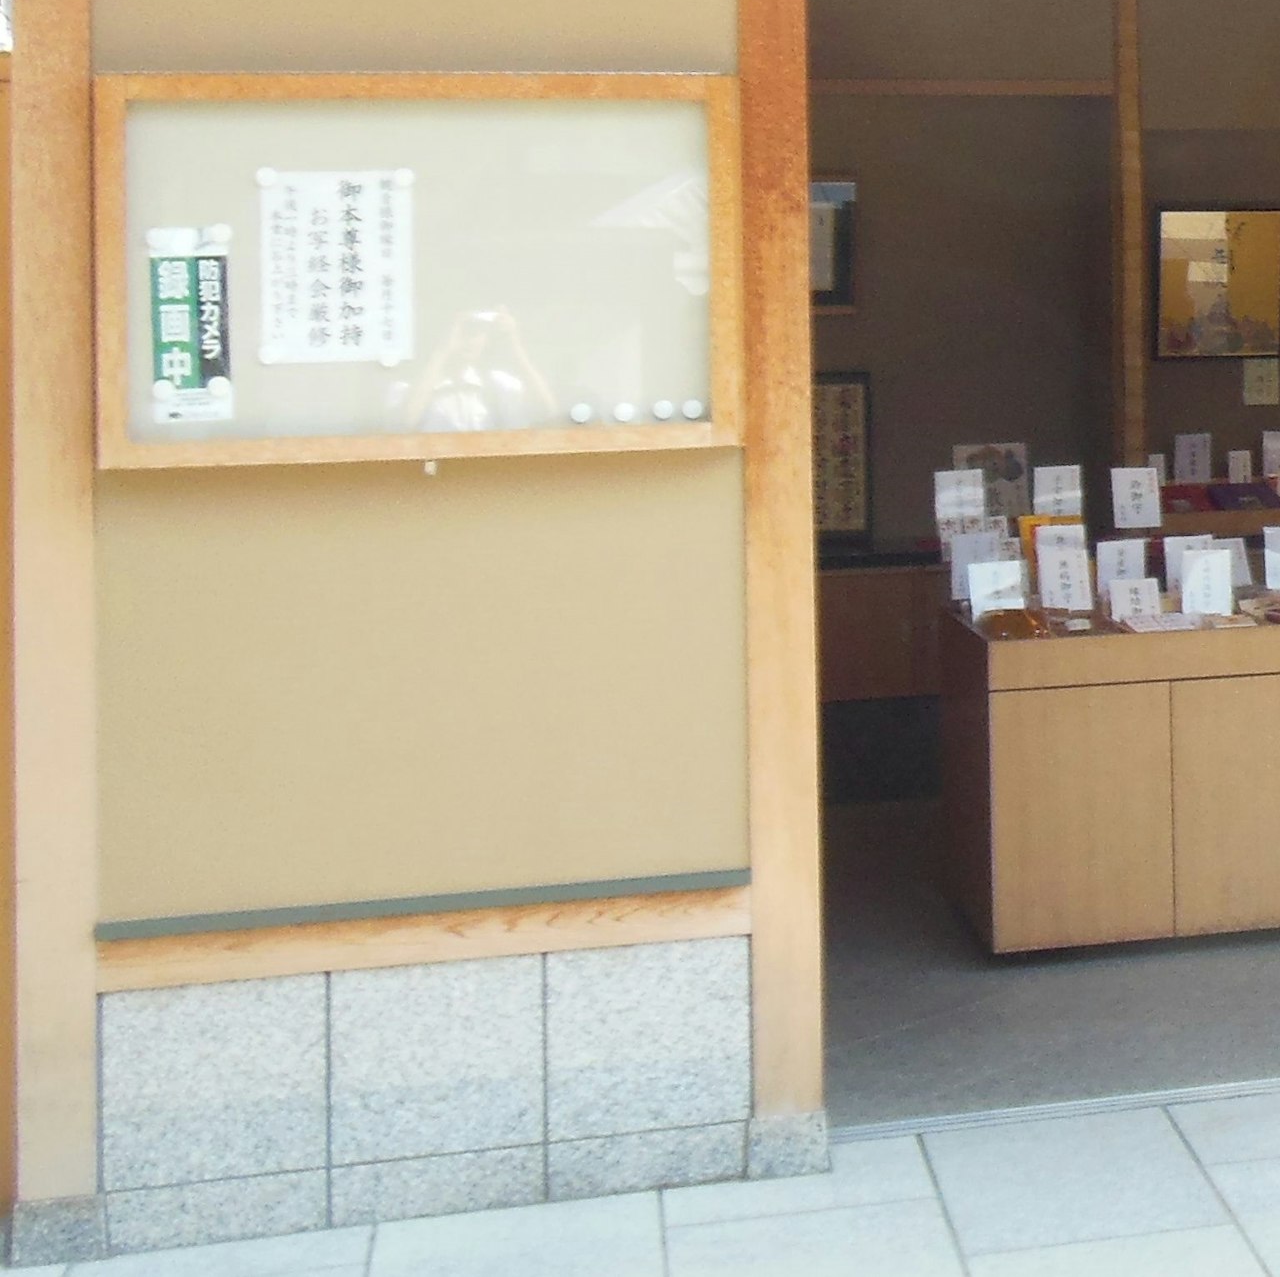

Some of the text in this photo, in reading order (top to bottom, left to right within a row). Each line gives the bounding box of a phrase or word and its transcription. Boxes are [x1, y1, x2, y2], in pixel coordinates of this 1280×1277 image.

[157, 260, 193, 386] 録画中
[198, 259, 222, 360] 防犯カメラ
[307, 208, 332, 346] お写経会厳修
[338, 179, 364, 346] 御本尊様御加持
